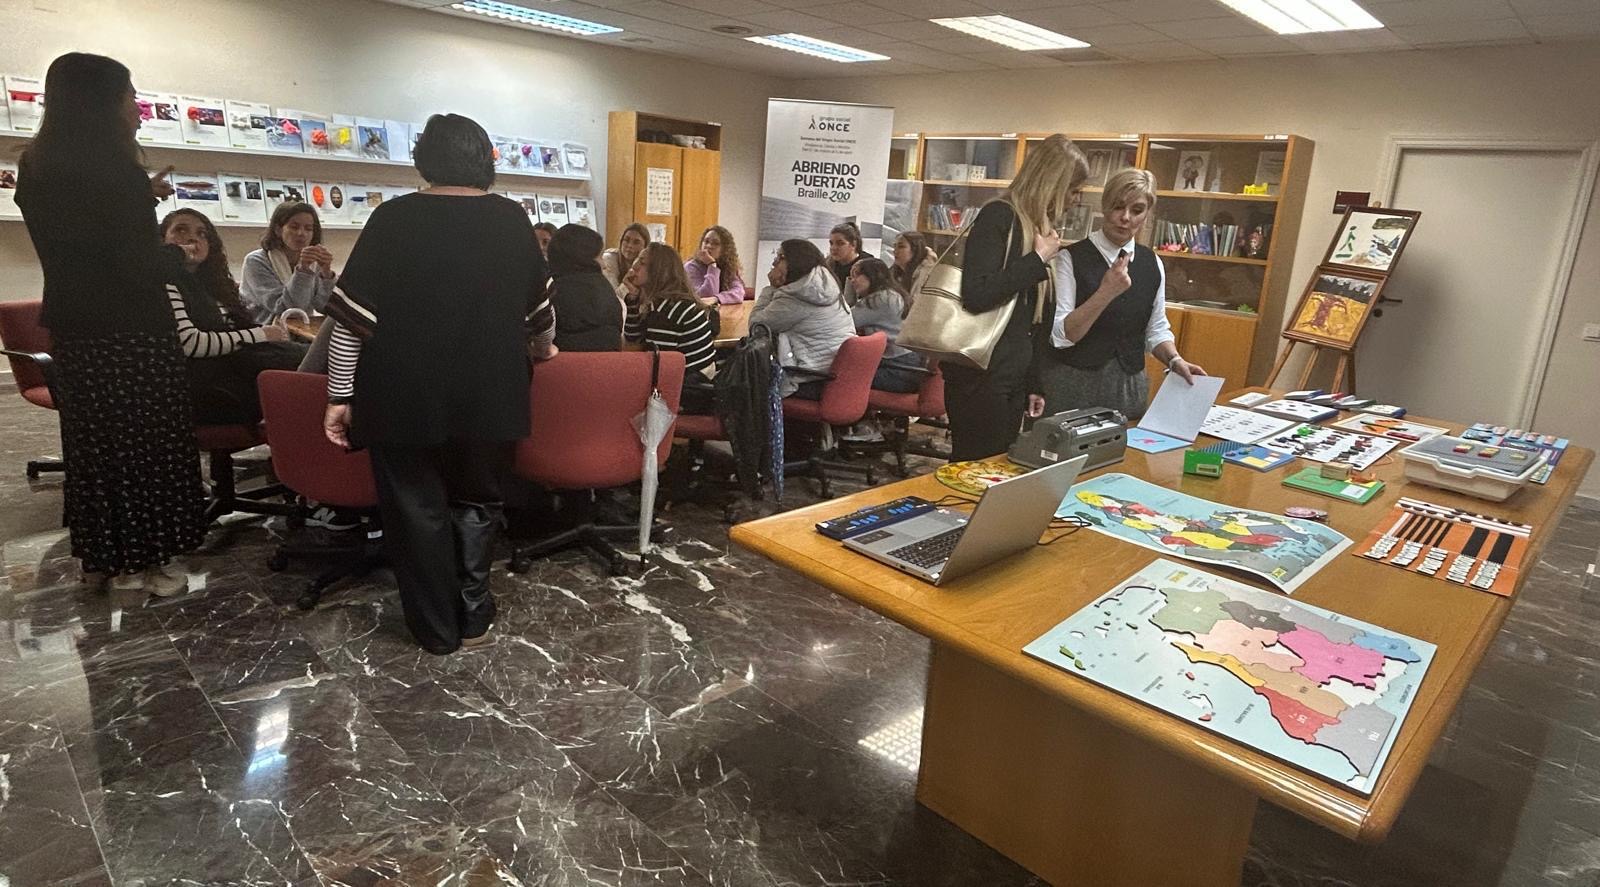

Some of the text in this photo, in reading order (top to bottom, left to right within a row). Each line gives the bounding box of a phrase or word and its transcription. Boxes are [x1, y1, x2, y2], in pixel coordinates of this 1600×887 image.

[819, 122, 850, 132] ONCE
[791, 160, 861, 176] ABRIENDO
[794, 174, 856, 190] PUERTAS
[798, 187, 851, 202] Braille 200
